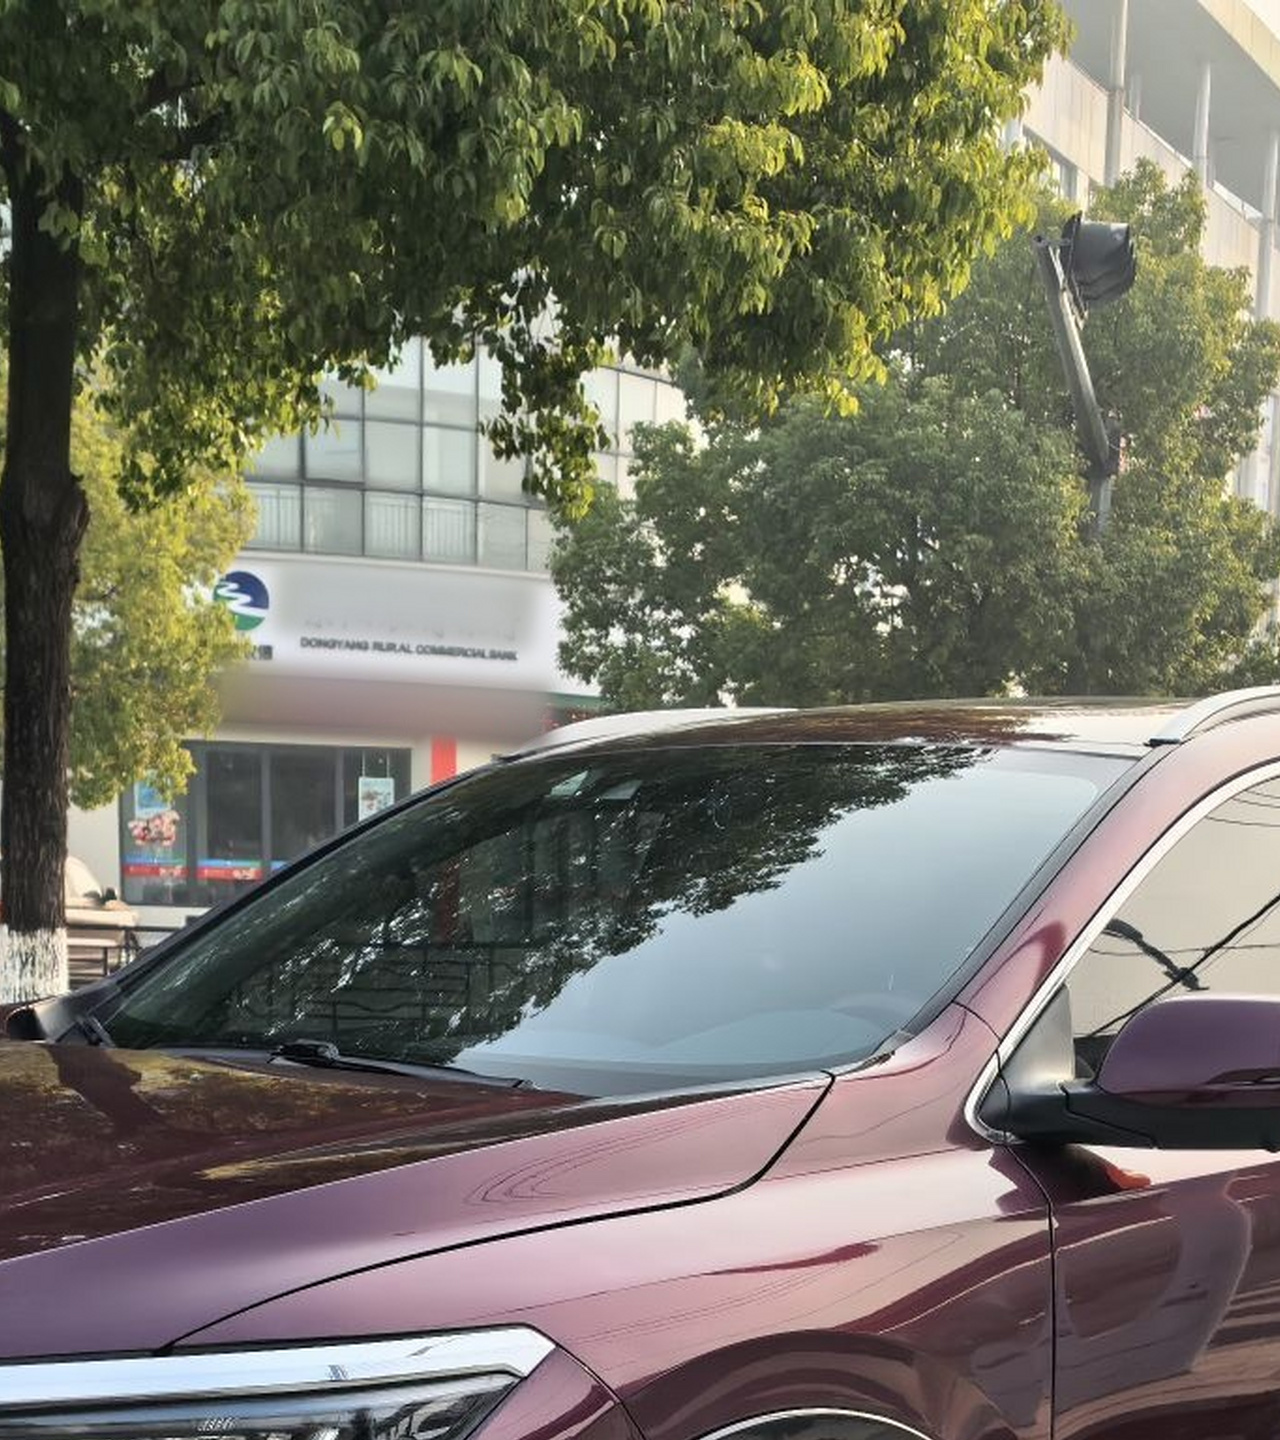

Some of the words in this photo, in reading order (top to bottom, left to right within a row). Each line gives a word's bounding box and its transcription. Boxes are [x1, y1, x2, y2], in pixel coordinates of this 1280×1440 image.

[300, 636, 370, 651] DONGYANG
[372, 641, 413, 654] RURAL
[416, 644, 489, 659] COMMERCIAL
